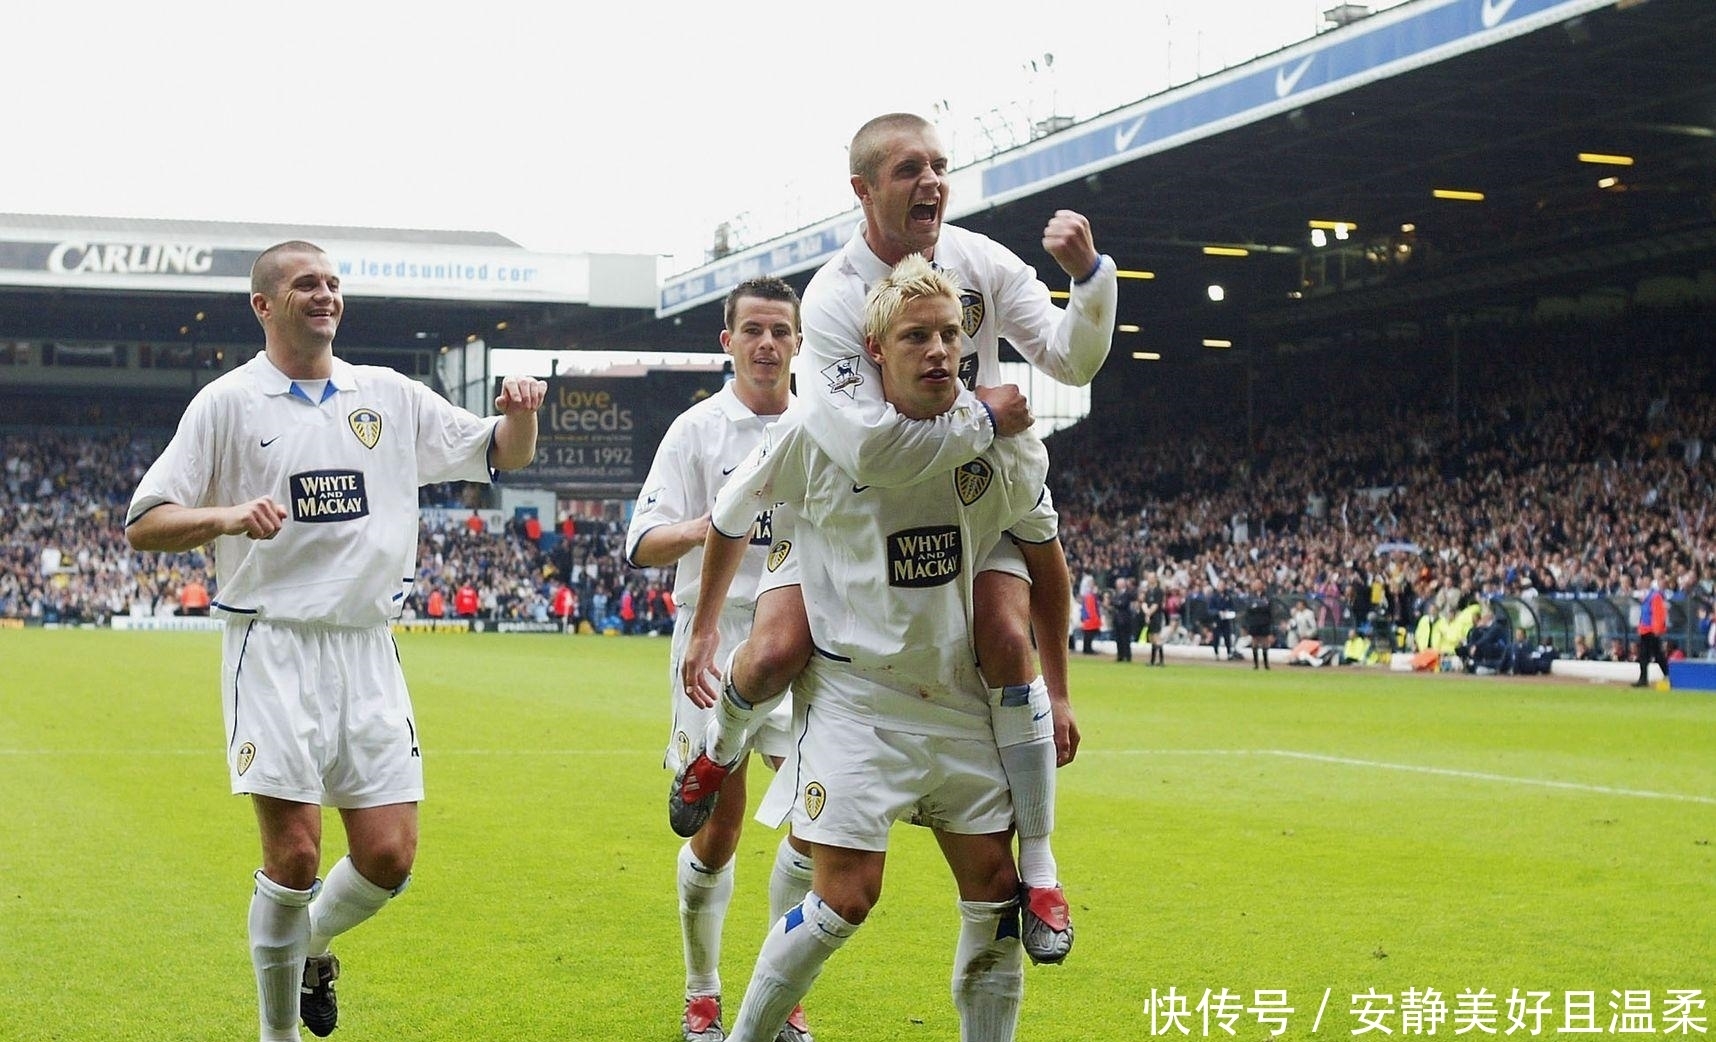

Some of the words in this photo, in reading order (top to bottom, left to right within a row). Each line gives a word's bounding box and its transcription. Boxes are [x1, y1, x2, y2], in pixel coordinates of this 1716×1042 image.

[47, 240, 213, 275] CARLING
[559, 386, 610, 408] love
[551, 402, 634, 431] leeds
[556, 447, 585, 465] 121
[594, 447, 634, 465] 1992
[299, 475, 358, 497] WHYTE
[319, 491, 344, 499] AND
[297, 497, 362, 518] MACKAY
[896, 531, 957, 557] WHYTE
[917, 551, 945, 561] AND
[894, 554, 958, 582] MACKAY
